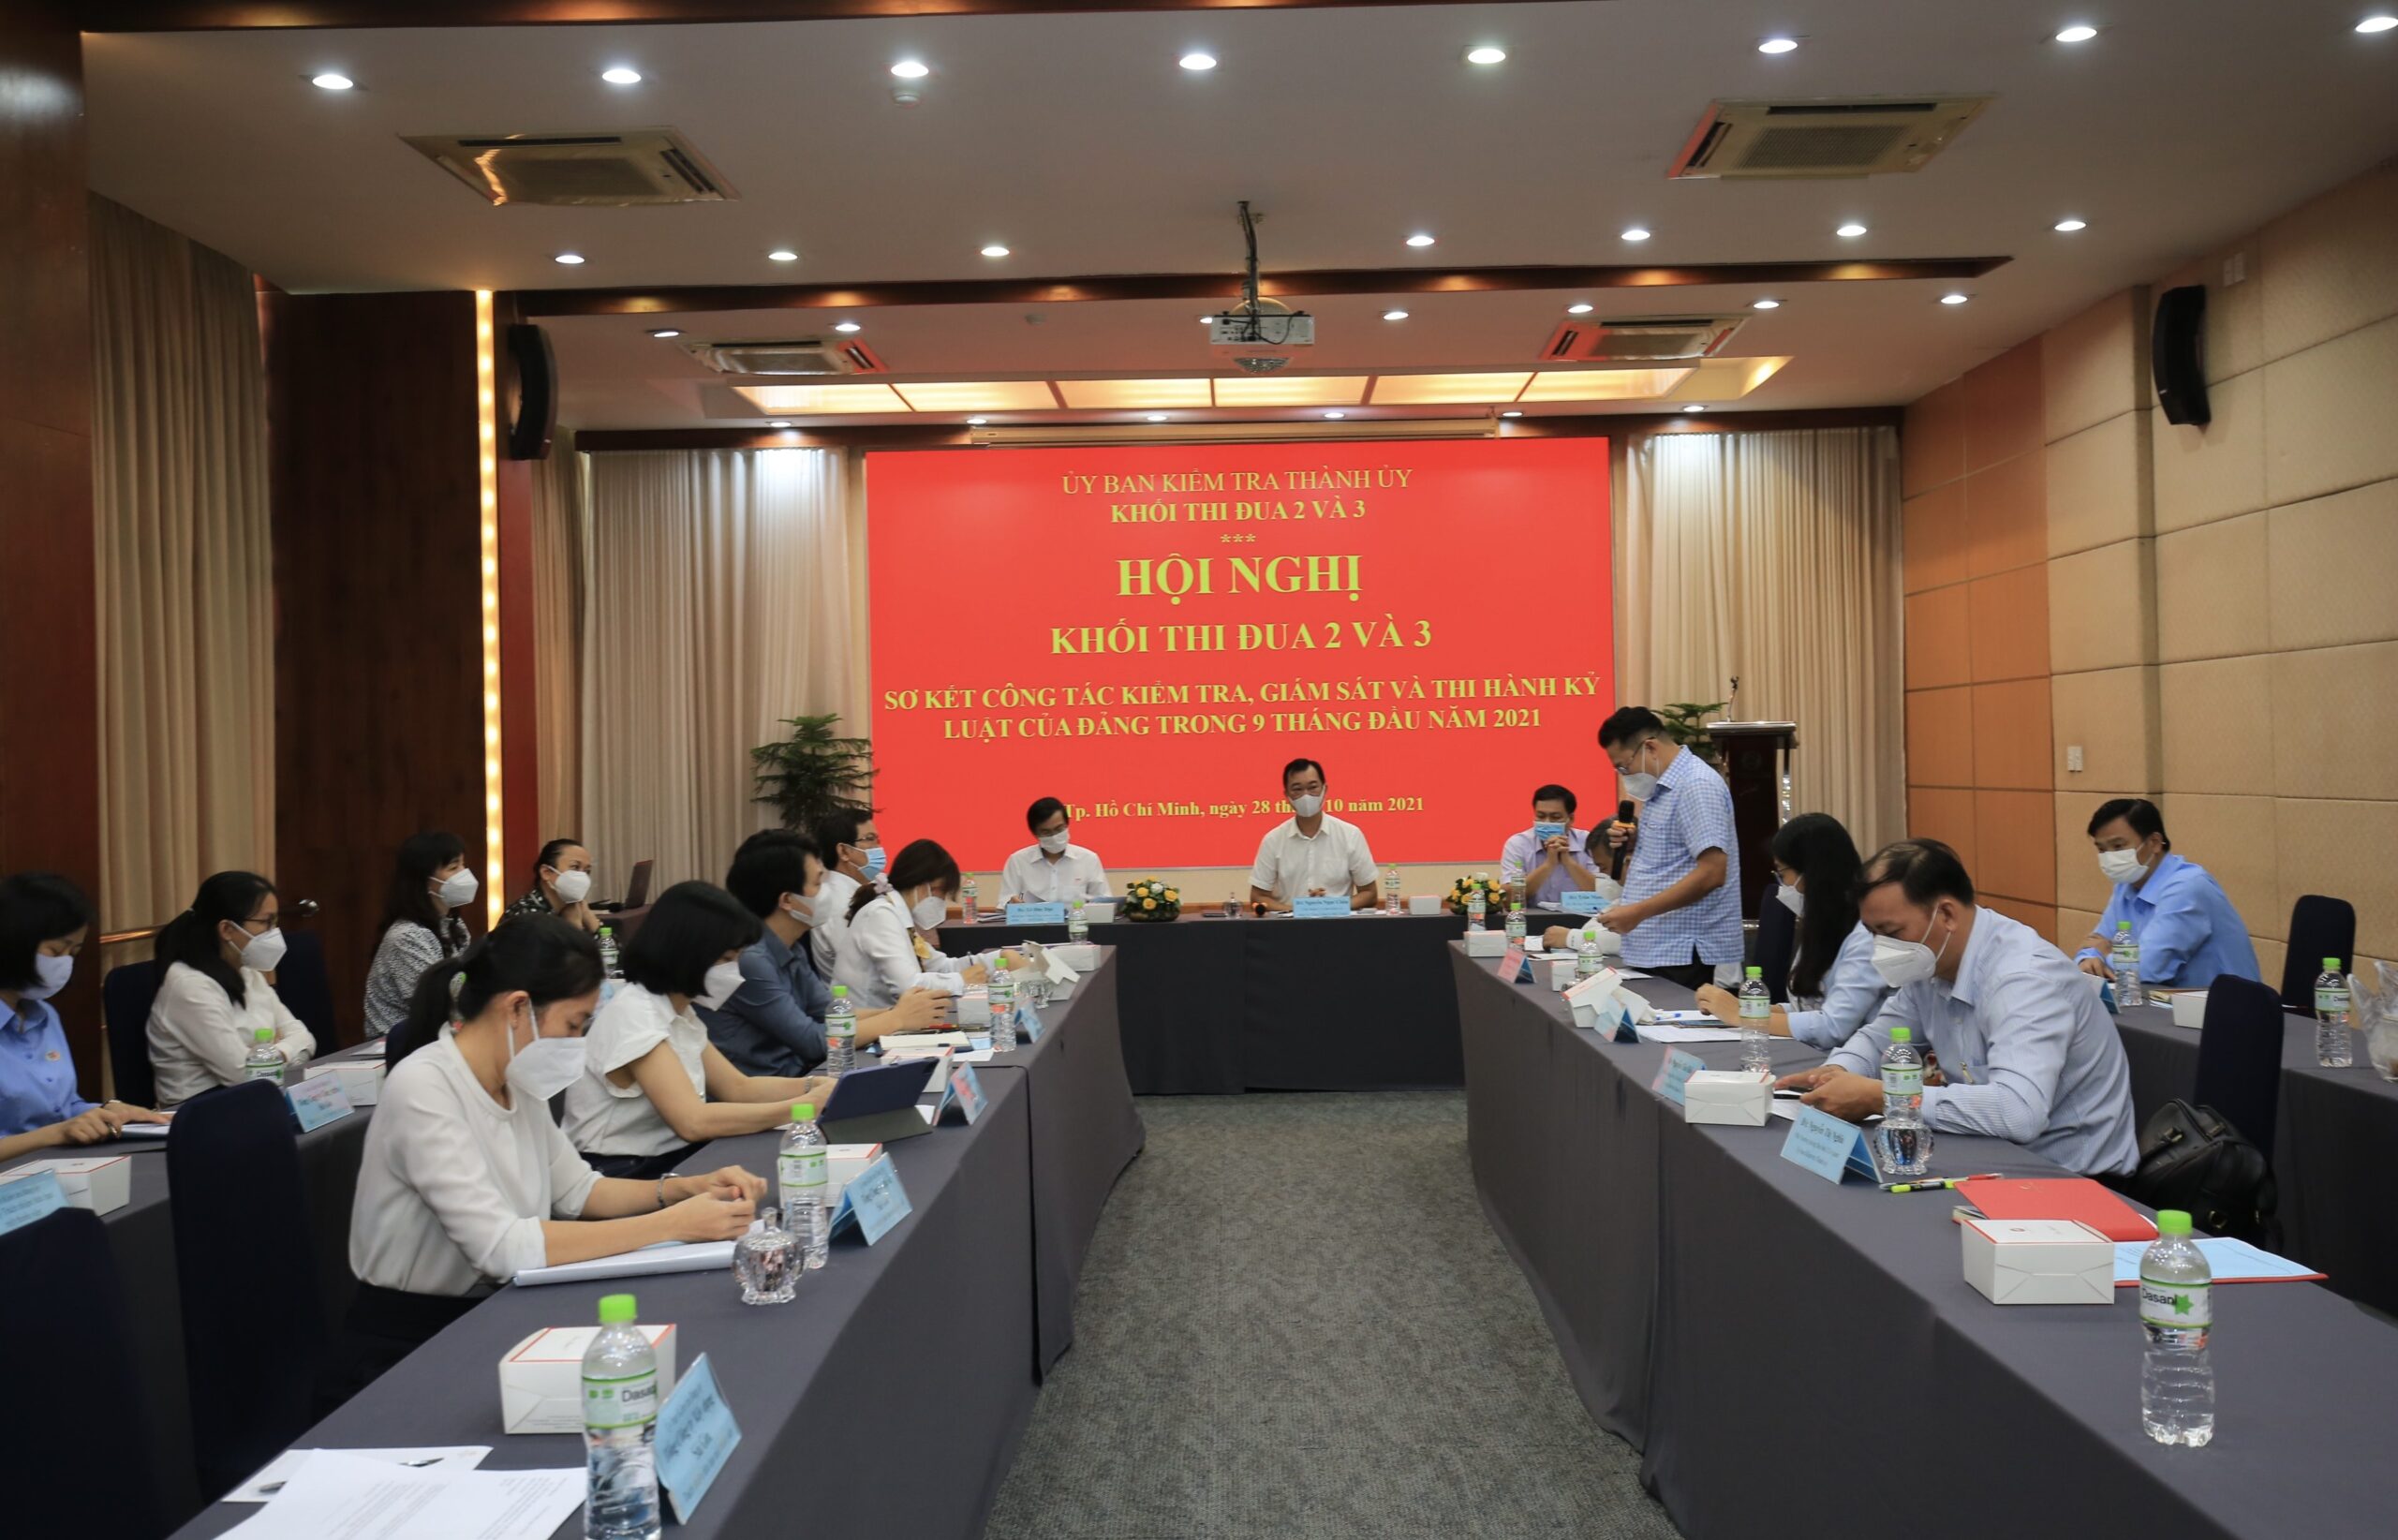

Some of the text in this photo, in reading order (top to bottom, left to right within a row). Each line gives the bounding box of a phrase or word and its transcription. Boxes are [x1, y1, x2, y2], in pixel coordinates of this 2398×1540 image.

[1061, 464, 1414, 495] ỦY BAN KIỂM TRA THÀNH ỦY
[1110, 494, 1367, 524] KHỐI THI ĐUA 2 VÀ 3
[1115, 552, 1364, 606] HỘI NGHỊ
[1049, 613, 1432, 655] KHỐI THI ĐUA 2 VÀ 3
[883, 670, 1601, 711] SƠ KẾT CÔNG TÁC KIỂM TRA, GIÁM SÁT VÀ THI HÀNH KỶ
[943, 704, 1541, 744] LUẬT CỦA ĐẢNG TRONG 9 THÁNG ĐẦU NĂM 2021
[1063, 803, 1092, 822] Tp.
[1094, 799, 1120, 818] Hồ
[1122, 802, 1153, 817] Chí
[1156, 801, 1206, 818] Minh,
[1208, 800, 1248, 819] ngày
[1251, 799, 1271, 814] 28
[1325, 798, 1344, 814] 10
[1347, 796, 1384, 813] năm
[1386, 796, 1425, 811] 2021
